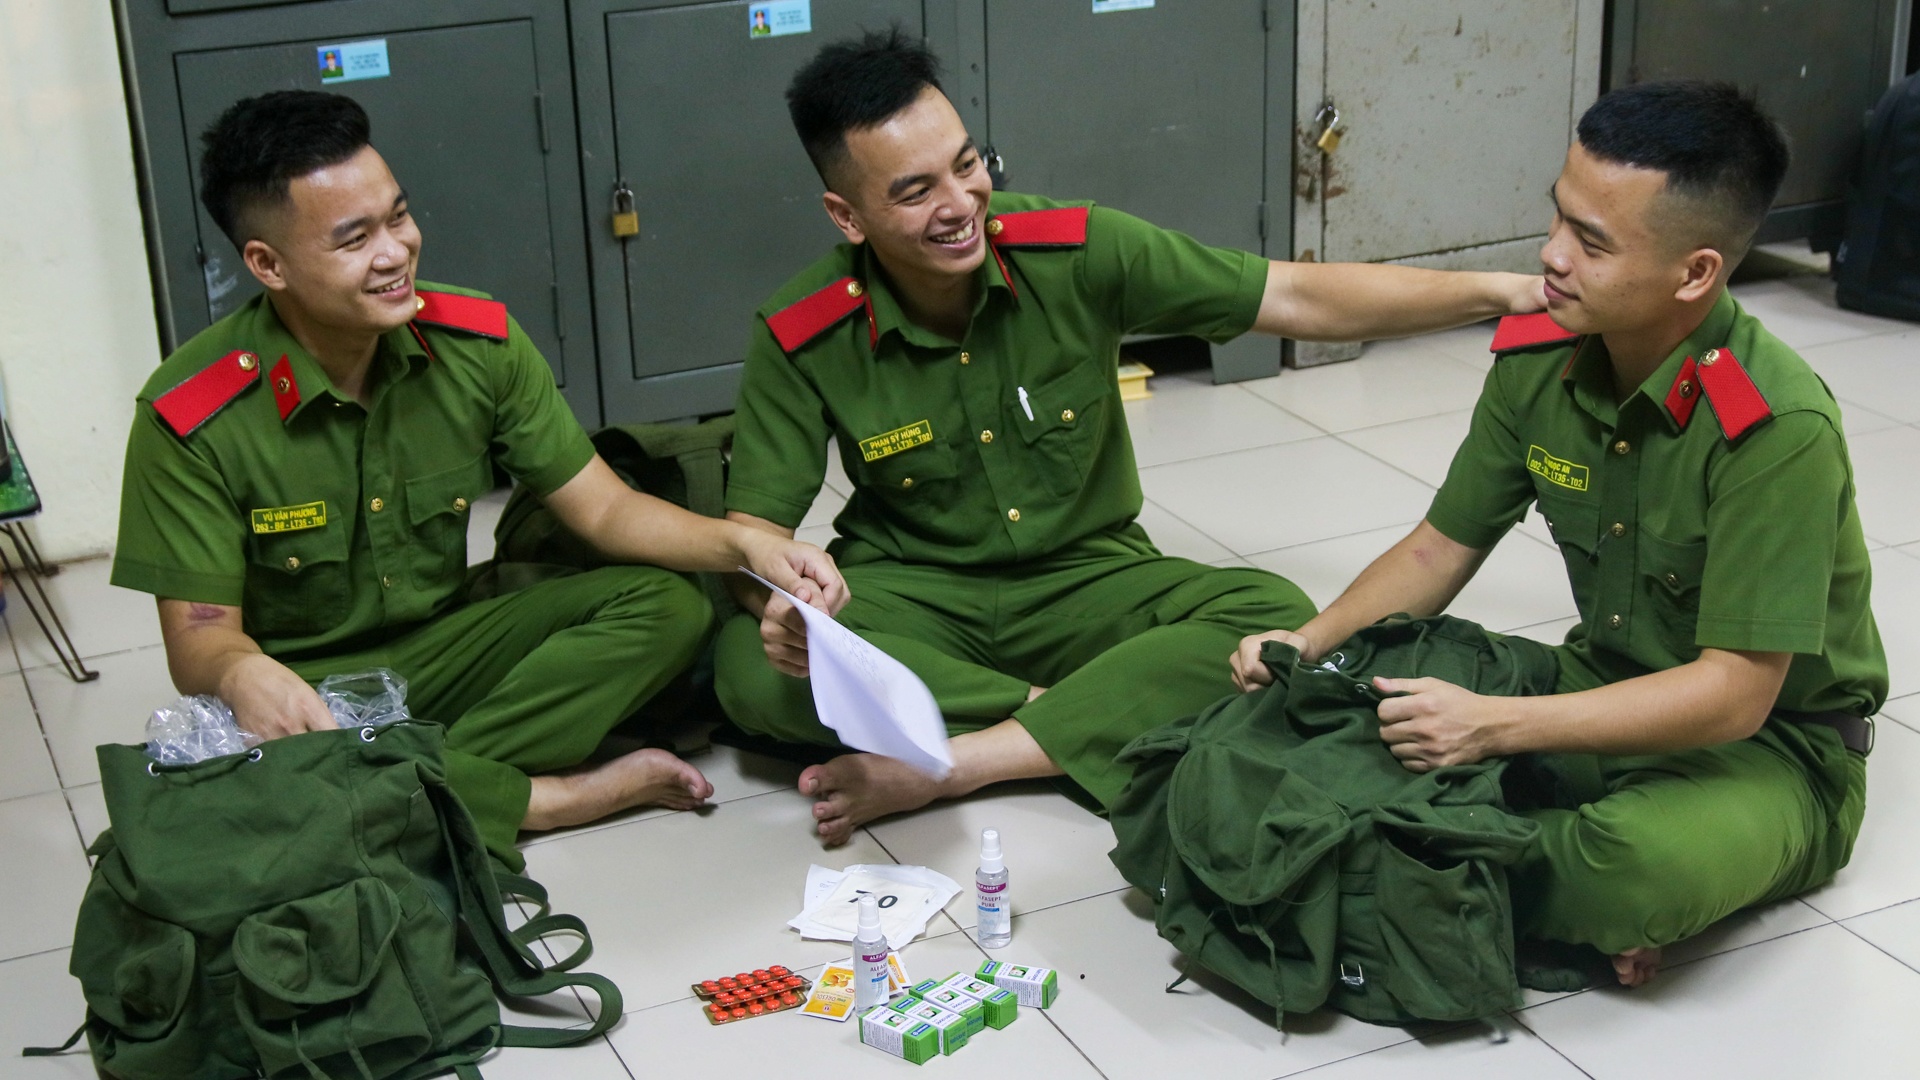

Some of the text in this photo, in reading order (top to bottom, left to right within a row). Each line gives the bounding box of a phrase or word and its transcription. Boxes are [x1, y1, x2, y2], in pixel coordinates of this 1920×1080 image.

[866, 450, 878, 460] 173
[897, 438, 914, 450] LT35
[918, 432, 931, 442] T02
[870, 437, 890, 449] PHAN
[1561, 465, 1571, 474] AN
[1550, 470, 1567, 483] LT35
[1571, 476, 1583, 488] T02
[290, 518, 307, 529] LT35
[976, 882, 999, 891] LFASEPT
[977, 893, 1001, 902] LFASEPT
